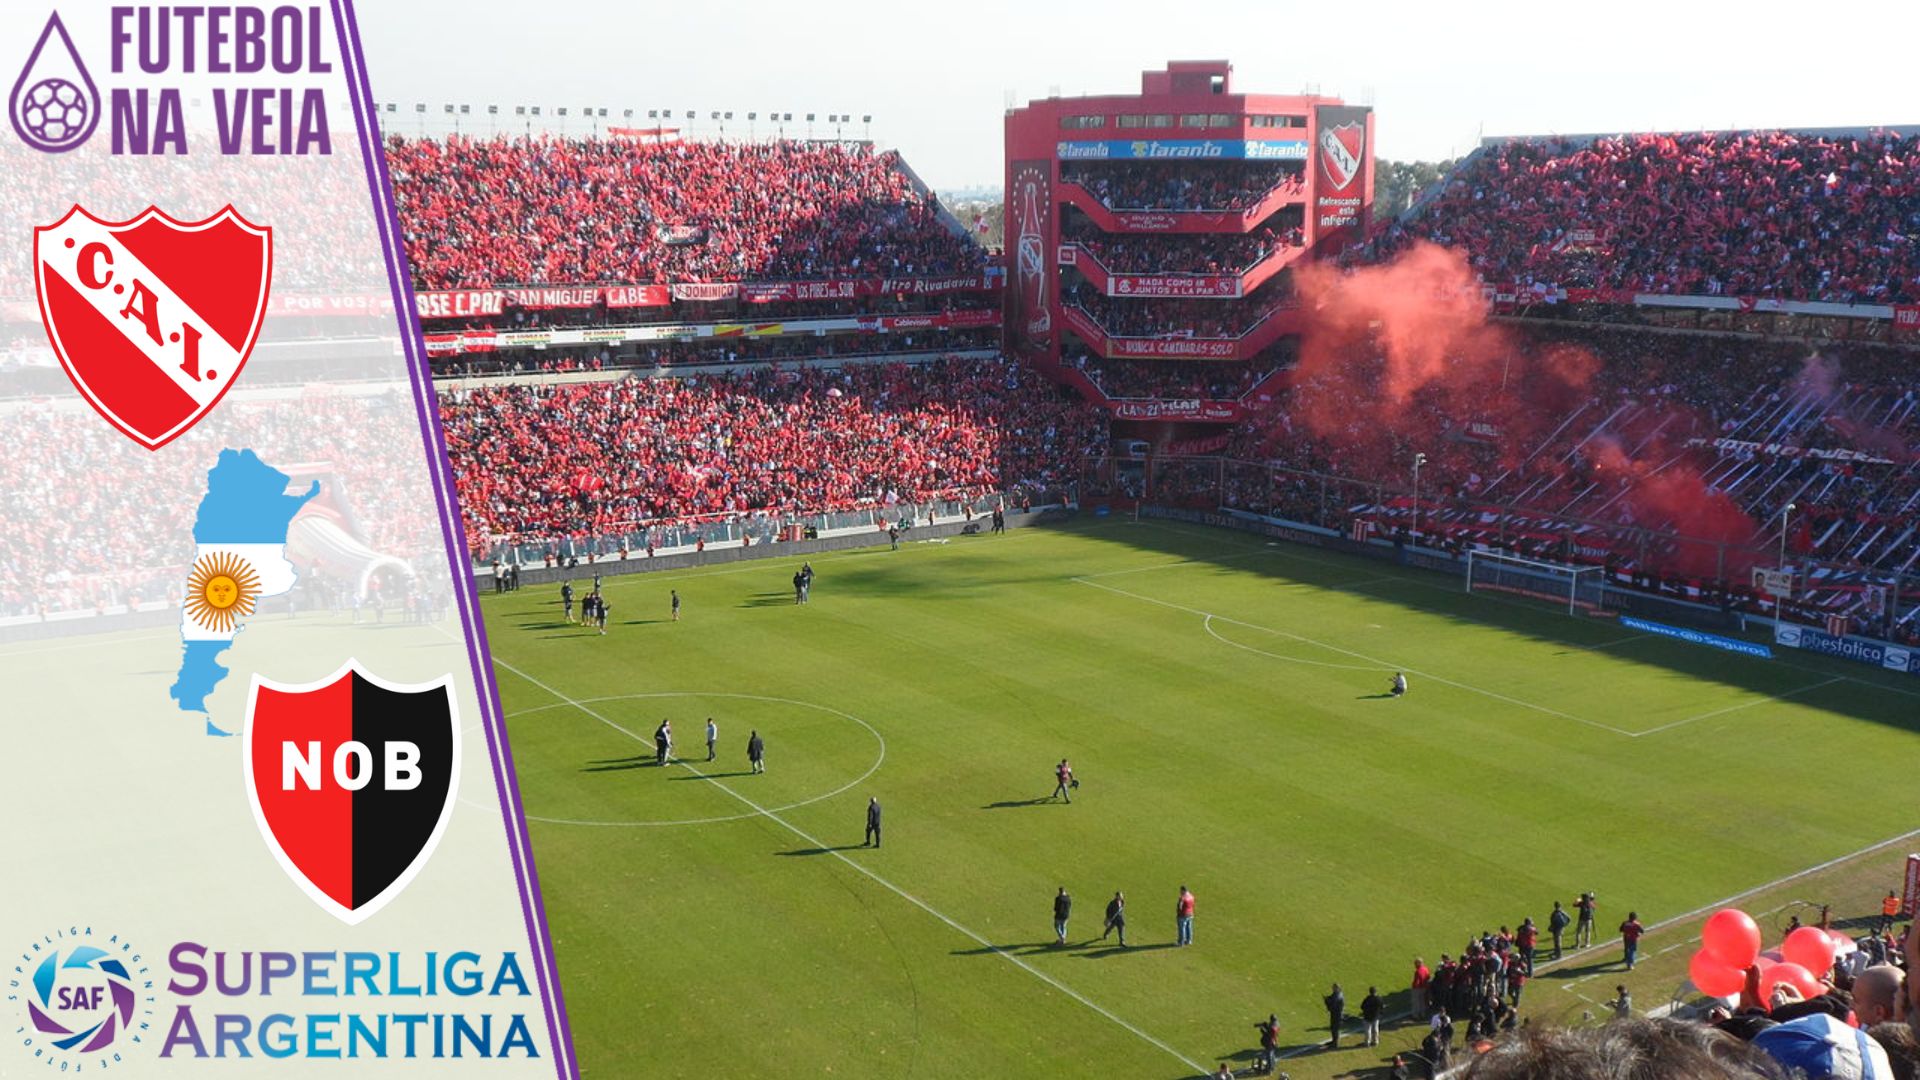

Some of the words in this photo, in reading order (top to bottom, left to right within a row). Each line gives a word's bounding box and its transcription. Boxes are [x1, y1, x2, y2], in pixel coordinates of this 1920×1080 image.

[1067, 142, 1109, 157] taranto
[1149, 141, 1222, 157] taranto
[1256, 140, 1308, 158] taranto
[1321, 214, 1358, 226] infierno
[914, 278, 977, 293] Rivadavia
[1133, 286, 1171, 294] JUNTOS
[1182, 286, 1194, 294] LA
[1139, 278, 1163, 286] NADA
[1166, 278, 1193, 287] COMO
[543, 289, 599, 305] MIGUEL
[608, 287, 648, 304] CABE
[416, 293, 452, 316] OSE
[1624, 619, 1677, 637] Allianz
[1702, 635, 1769, 657] Seguros
[1801, 632, 1881, 660] pbestatica
